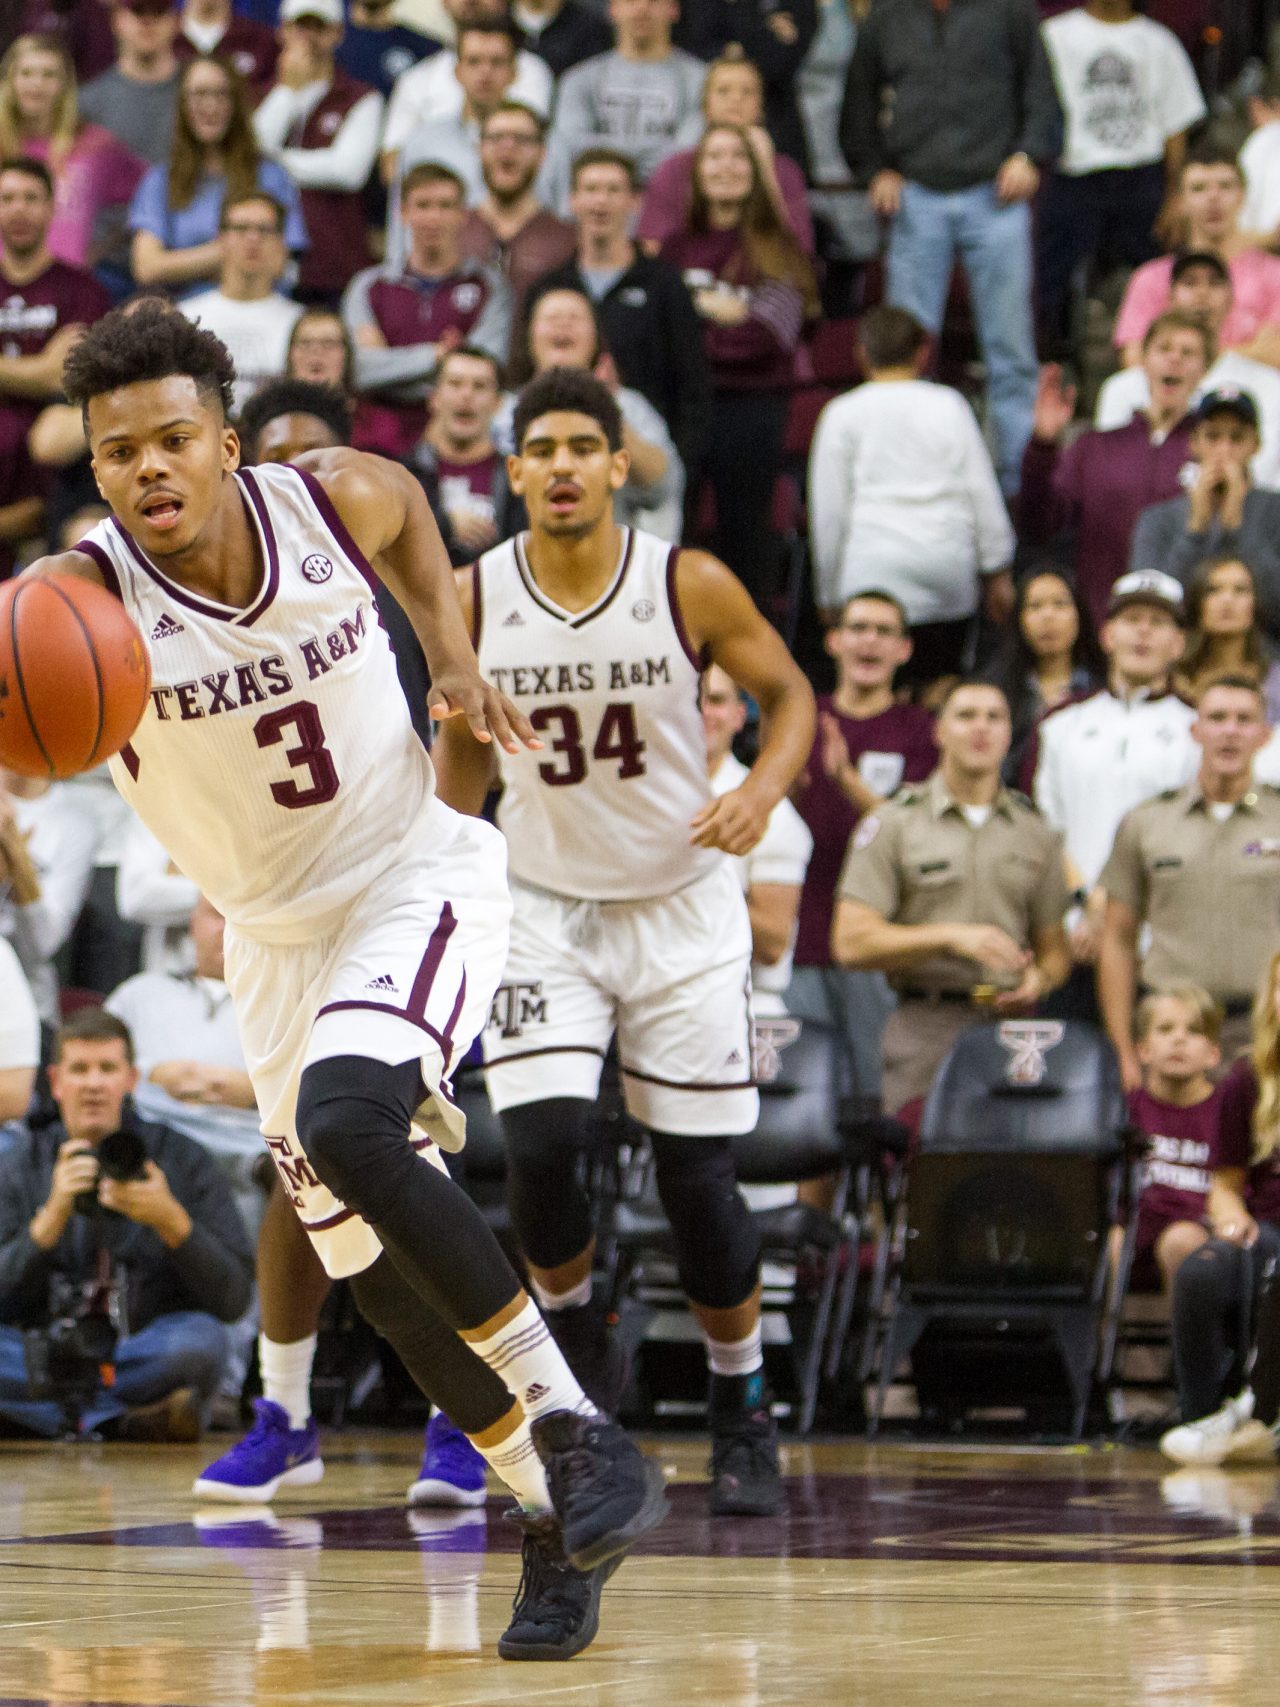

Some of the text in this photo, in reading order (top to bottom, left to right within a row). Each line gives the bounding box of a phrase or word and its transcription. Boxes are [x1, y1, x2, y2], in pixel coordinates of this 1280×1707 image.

[303, 555, 332, 583] SEC
[149, 603, 368, 722] TEXAS A&M
[151, 624, 185, 641] adidas
[489, 655, 672, 696] TEXAS A&M
[252, 699, 341, 811] 3
[529, 701, 648, 787] 34
